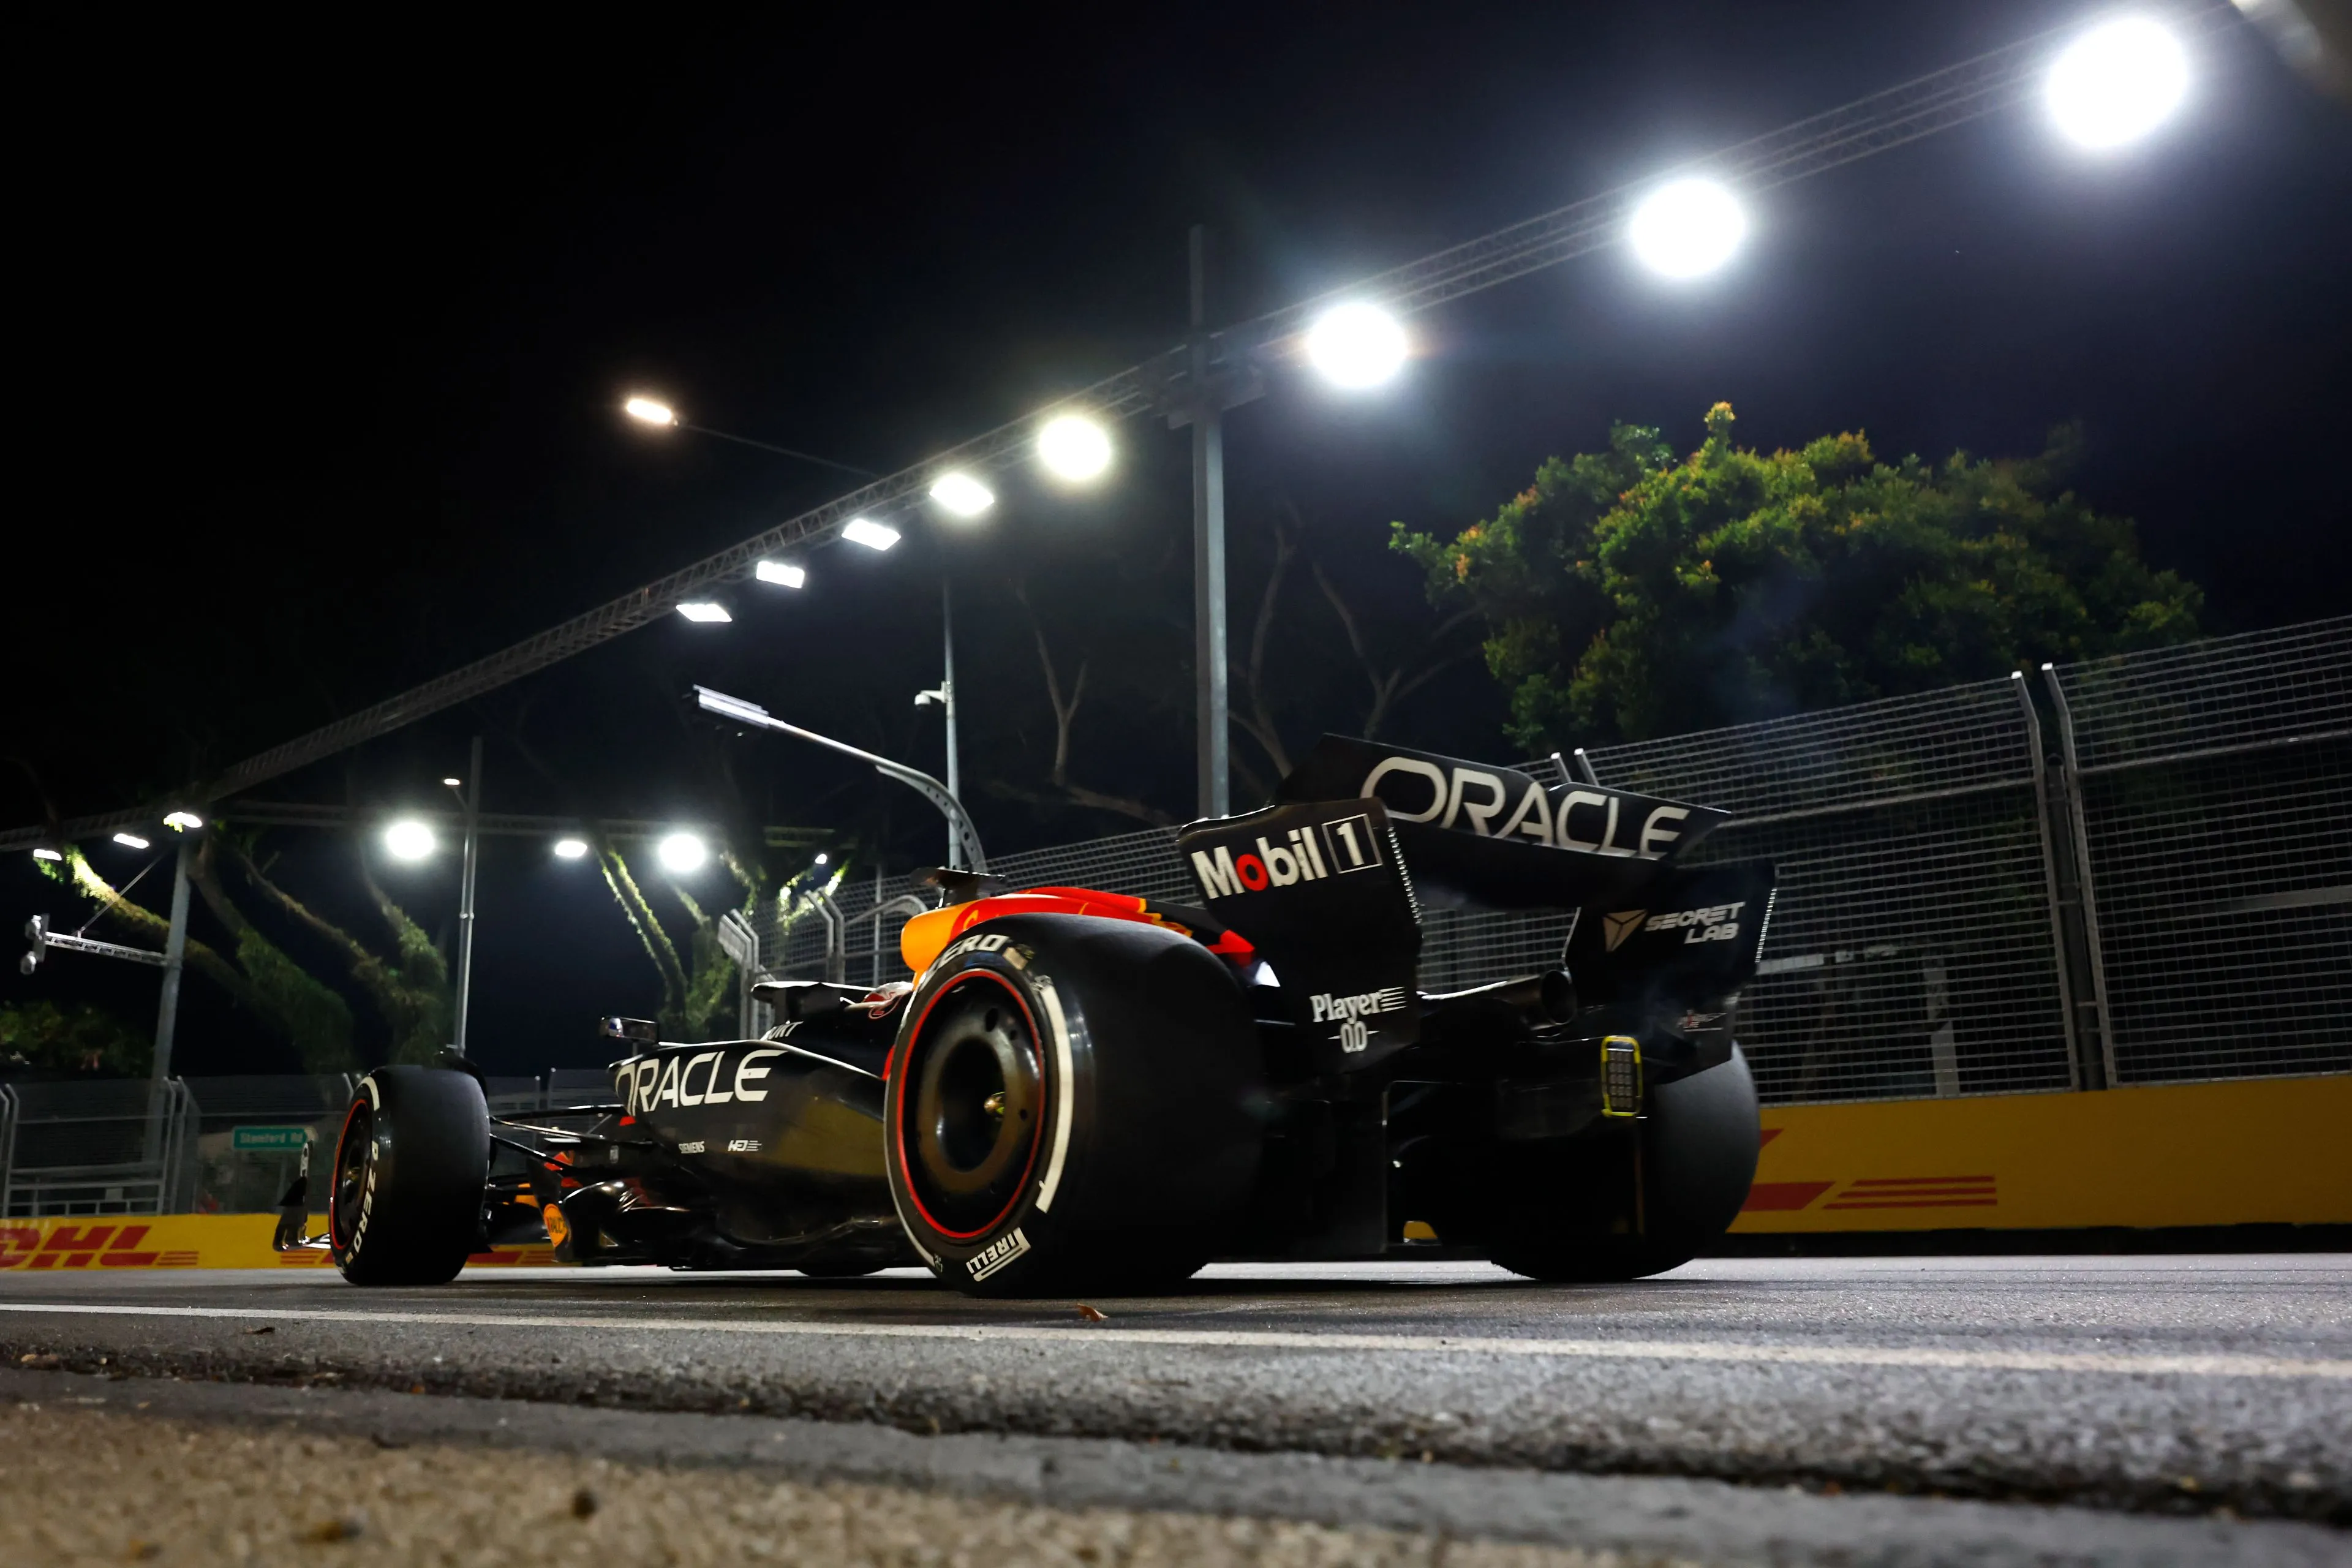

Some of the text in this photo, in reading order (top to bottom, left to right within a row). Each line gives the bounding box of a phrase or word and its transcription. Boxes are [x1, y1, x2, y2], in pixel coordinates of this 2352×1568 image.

[1360, 756, 1691, 860] ORACLE
[1191, 822, 1365, 899] Mobil 1
[1644, 902, 1746, 932] SECRET
[1684, 922, 1740, 944] LAB
[1309, 990, 1382, 1025] Player
[615, 1049, 788, 1117] ORACLE
[353, 1167, 376, 1253] ZERO
[966, 1227, 1031, 1282] PIRELLI
